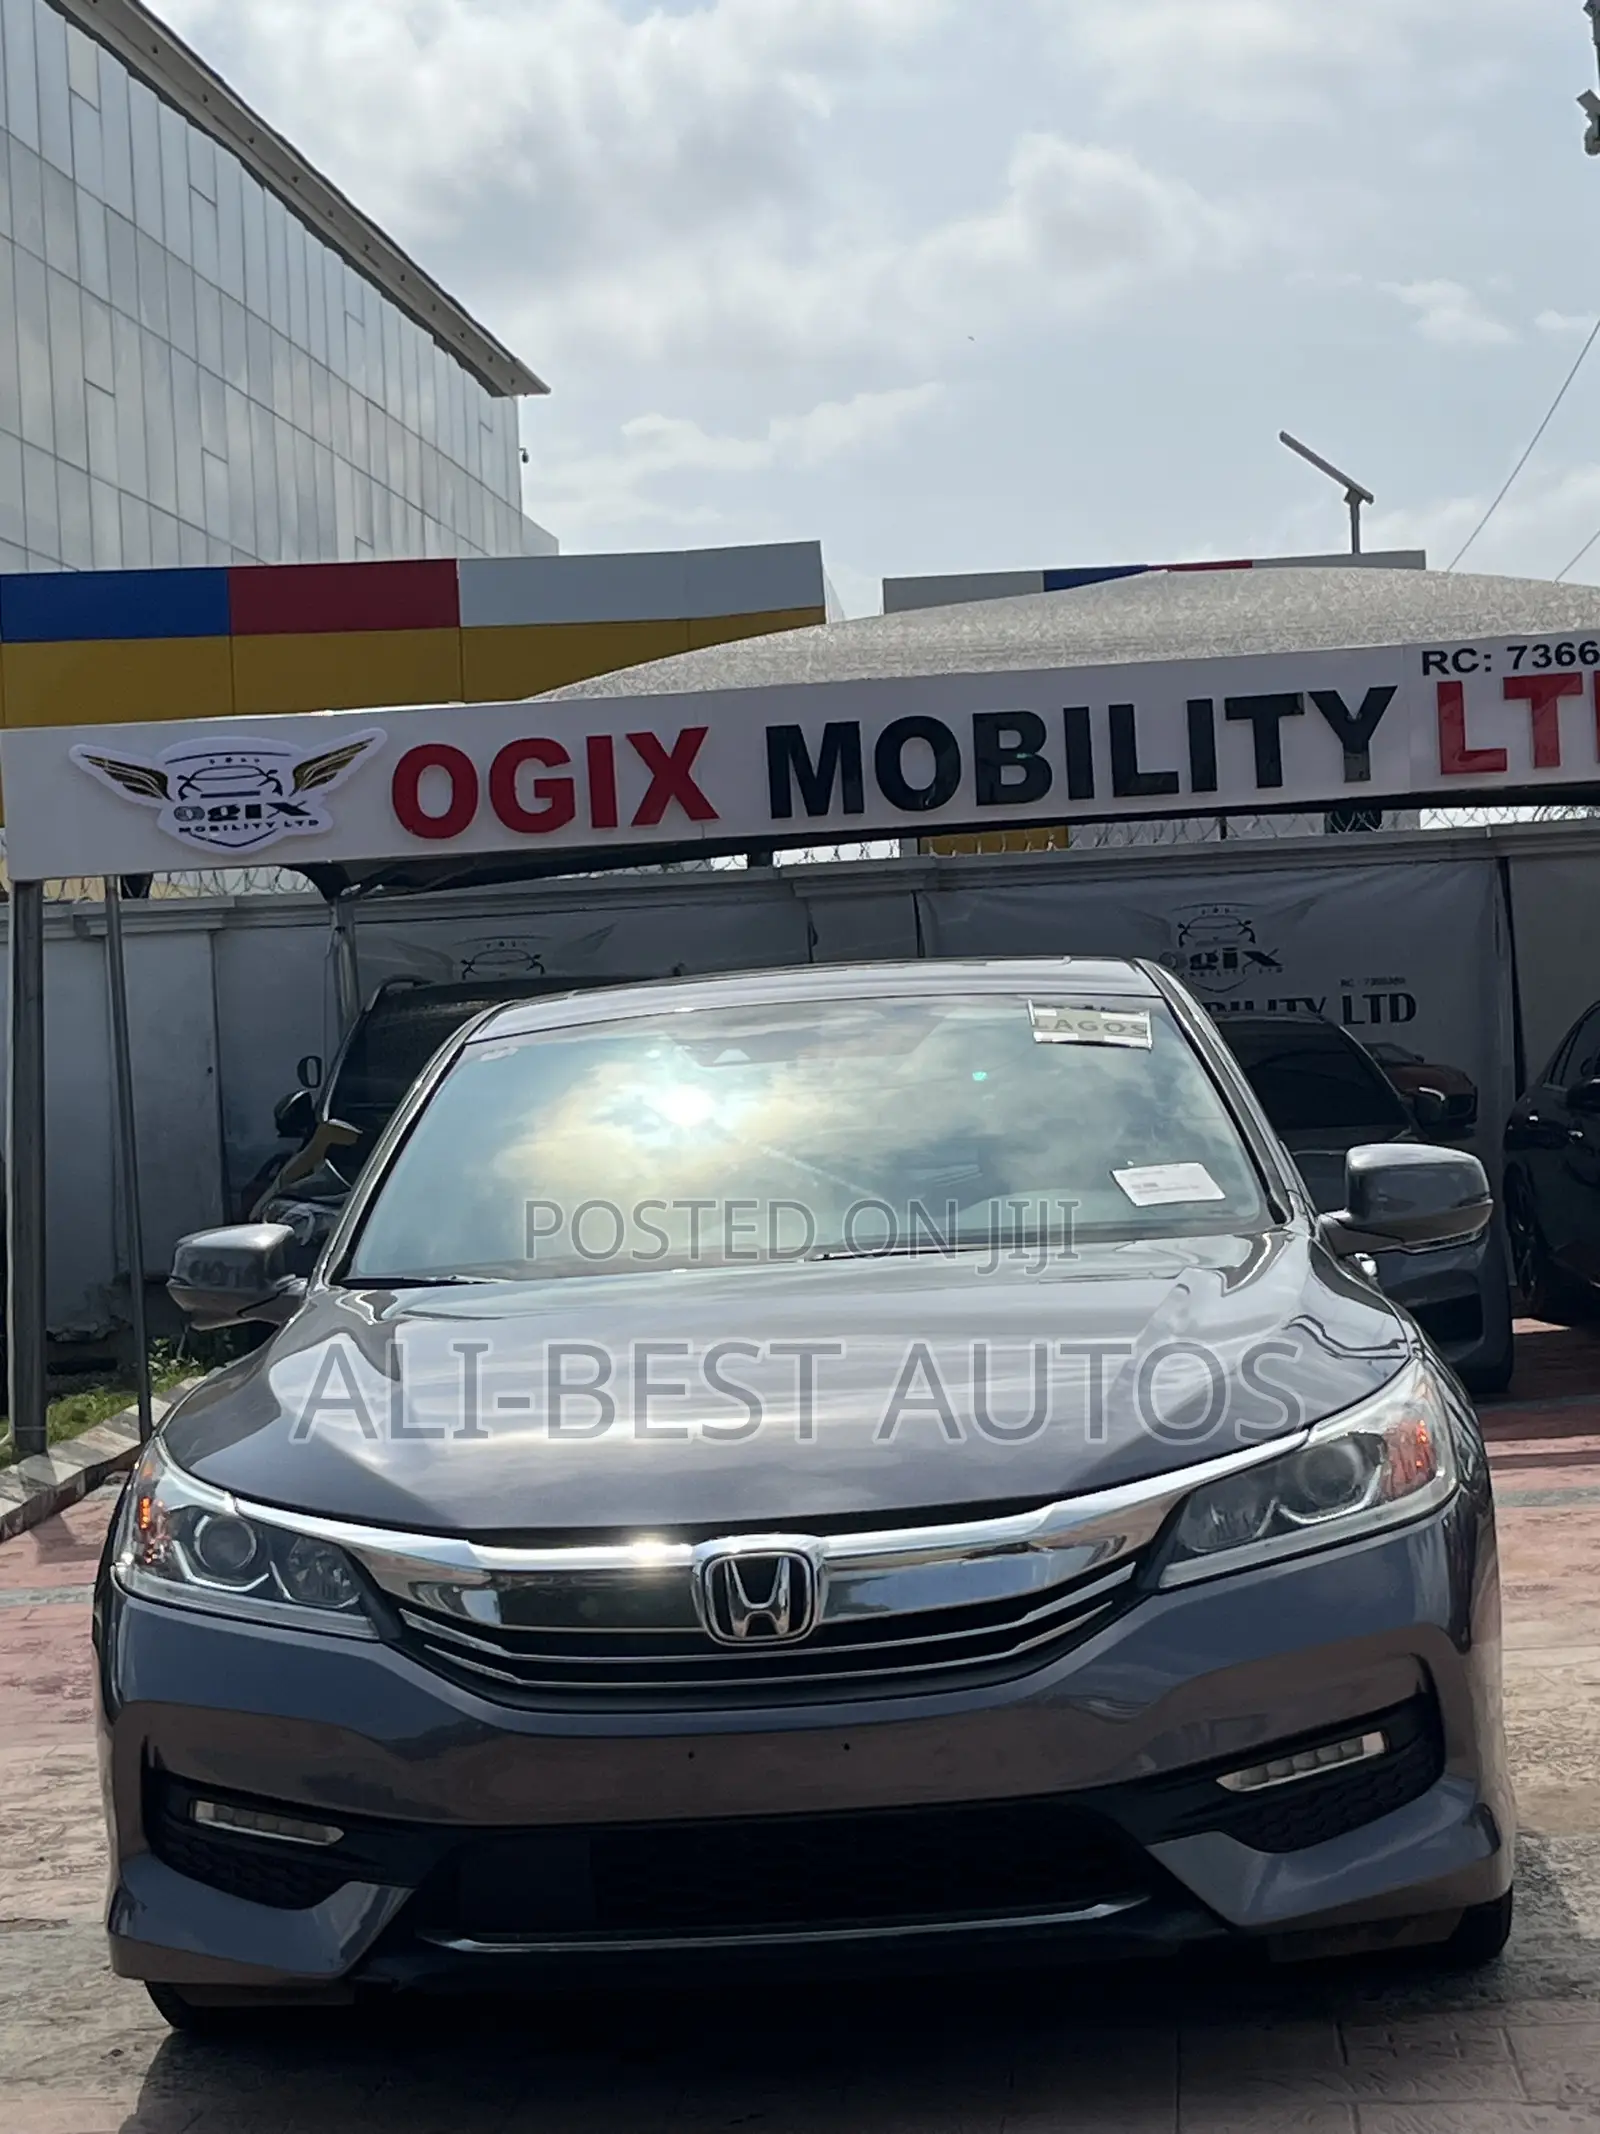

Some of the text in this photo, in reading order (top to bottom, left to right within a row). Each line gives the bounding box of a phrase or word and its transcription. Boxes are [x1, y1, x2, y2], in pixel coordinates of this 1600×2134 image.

[1421, 647, 1492, 677] RC:
[391, 670, 1600, 840] OGIX MOBILITY LT
[178, 818, 319, 834] MOBILITY LTD
[1341, 993, 1417, 1025] LTD
[1035, 1018, 1149, 1036] LAGOS
